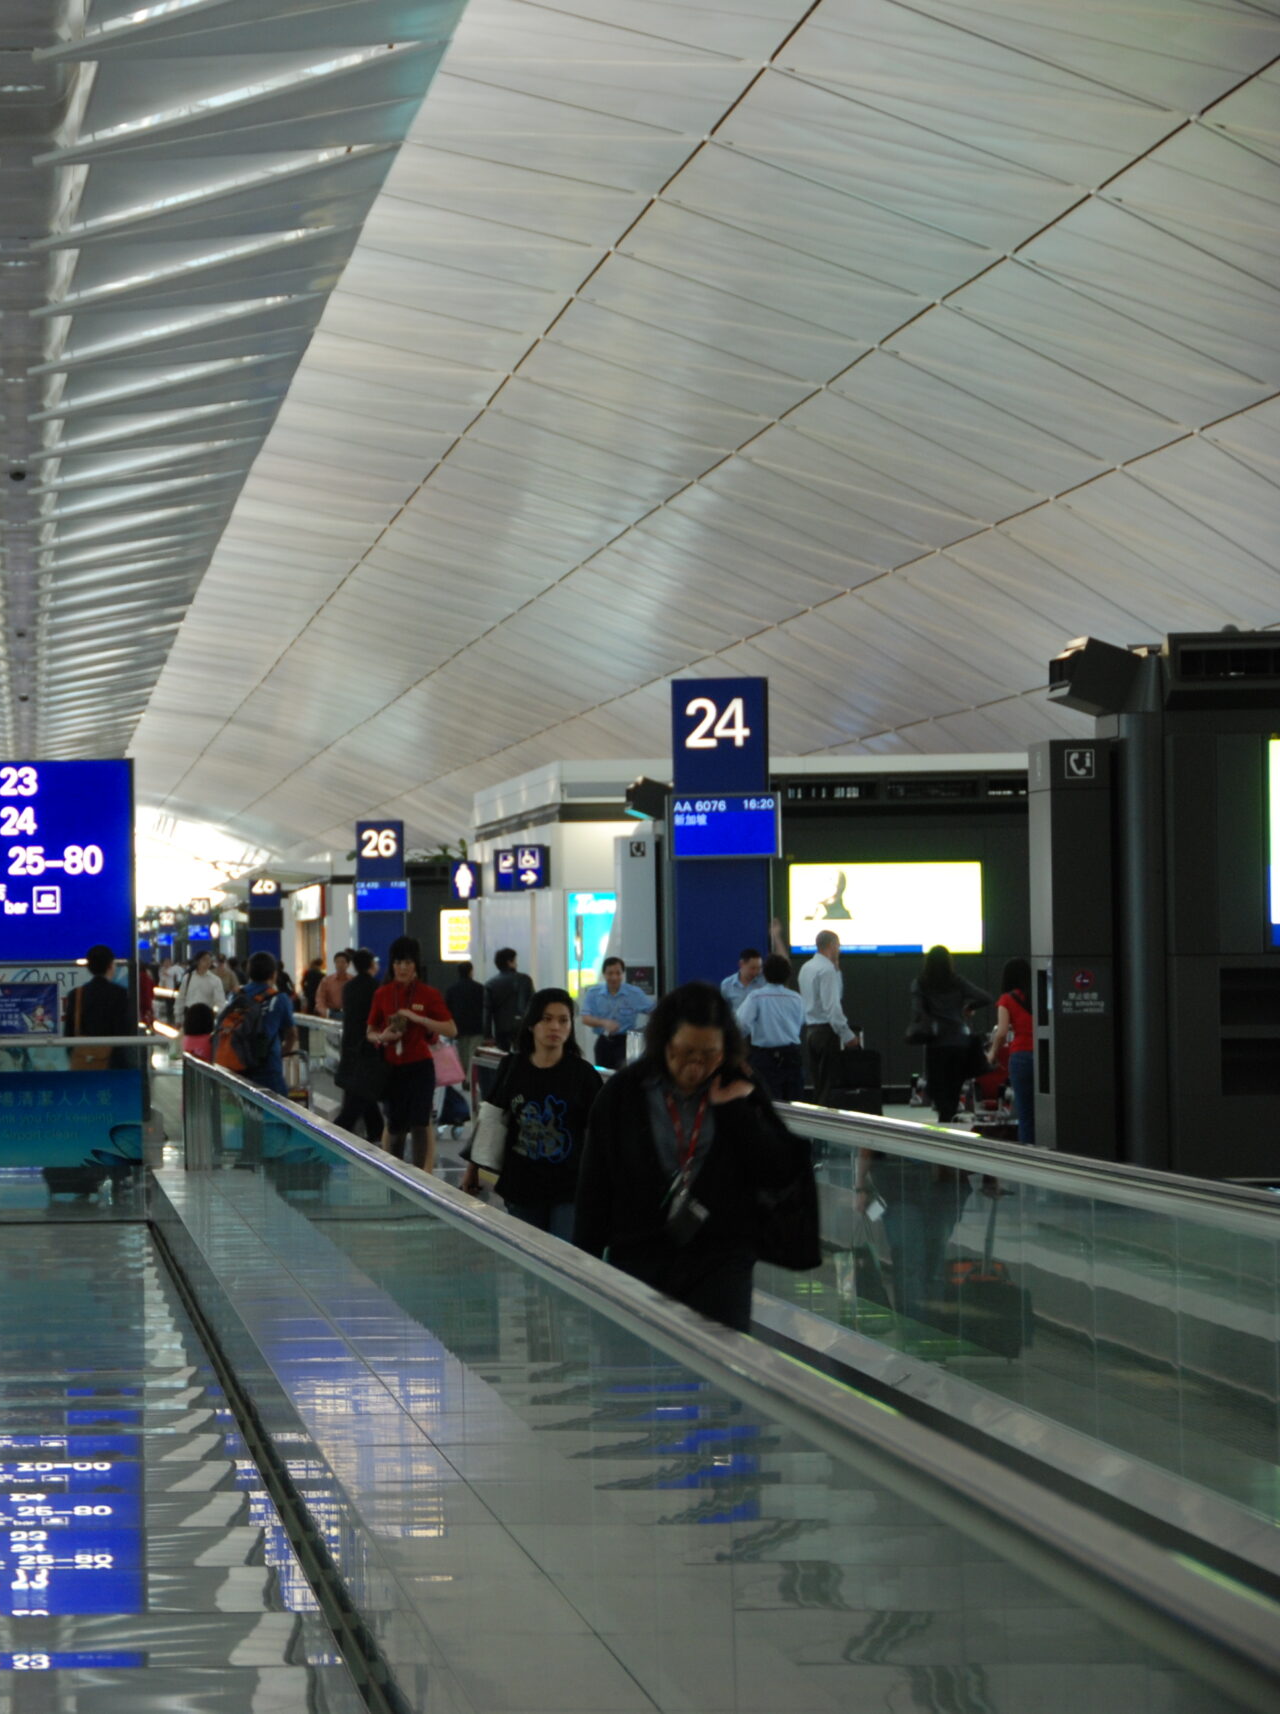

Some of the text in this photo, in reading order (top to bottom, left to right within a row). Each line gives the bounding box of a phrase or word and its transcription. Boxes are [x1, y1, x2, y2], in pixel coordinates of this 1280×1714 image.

[685, 697, 751, 749] 24
[0, 767, 38, 796] 23
[674, 798, 774, 812] AA 6076 16:20
[0, 806, 38, 836] 24
[361, 828, 397, 858] 26
[190, 899, 209, 915] 30
